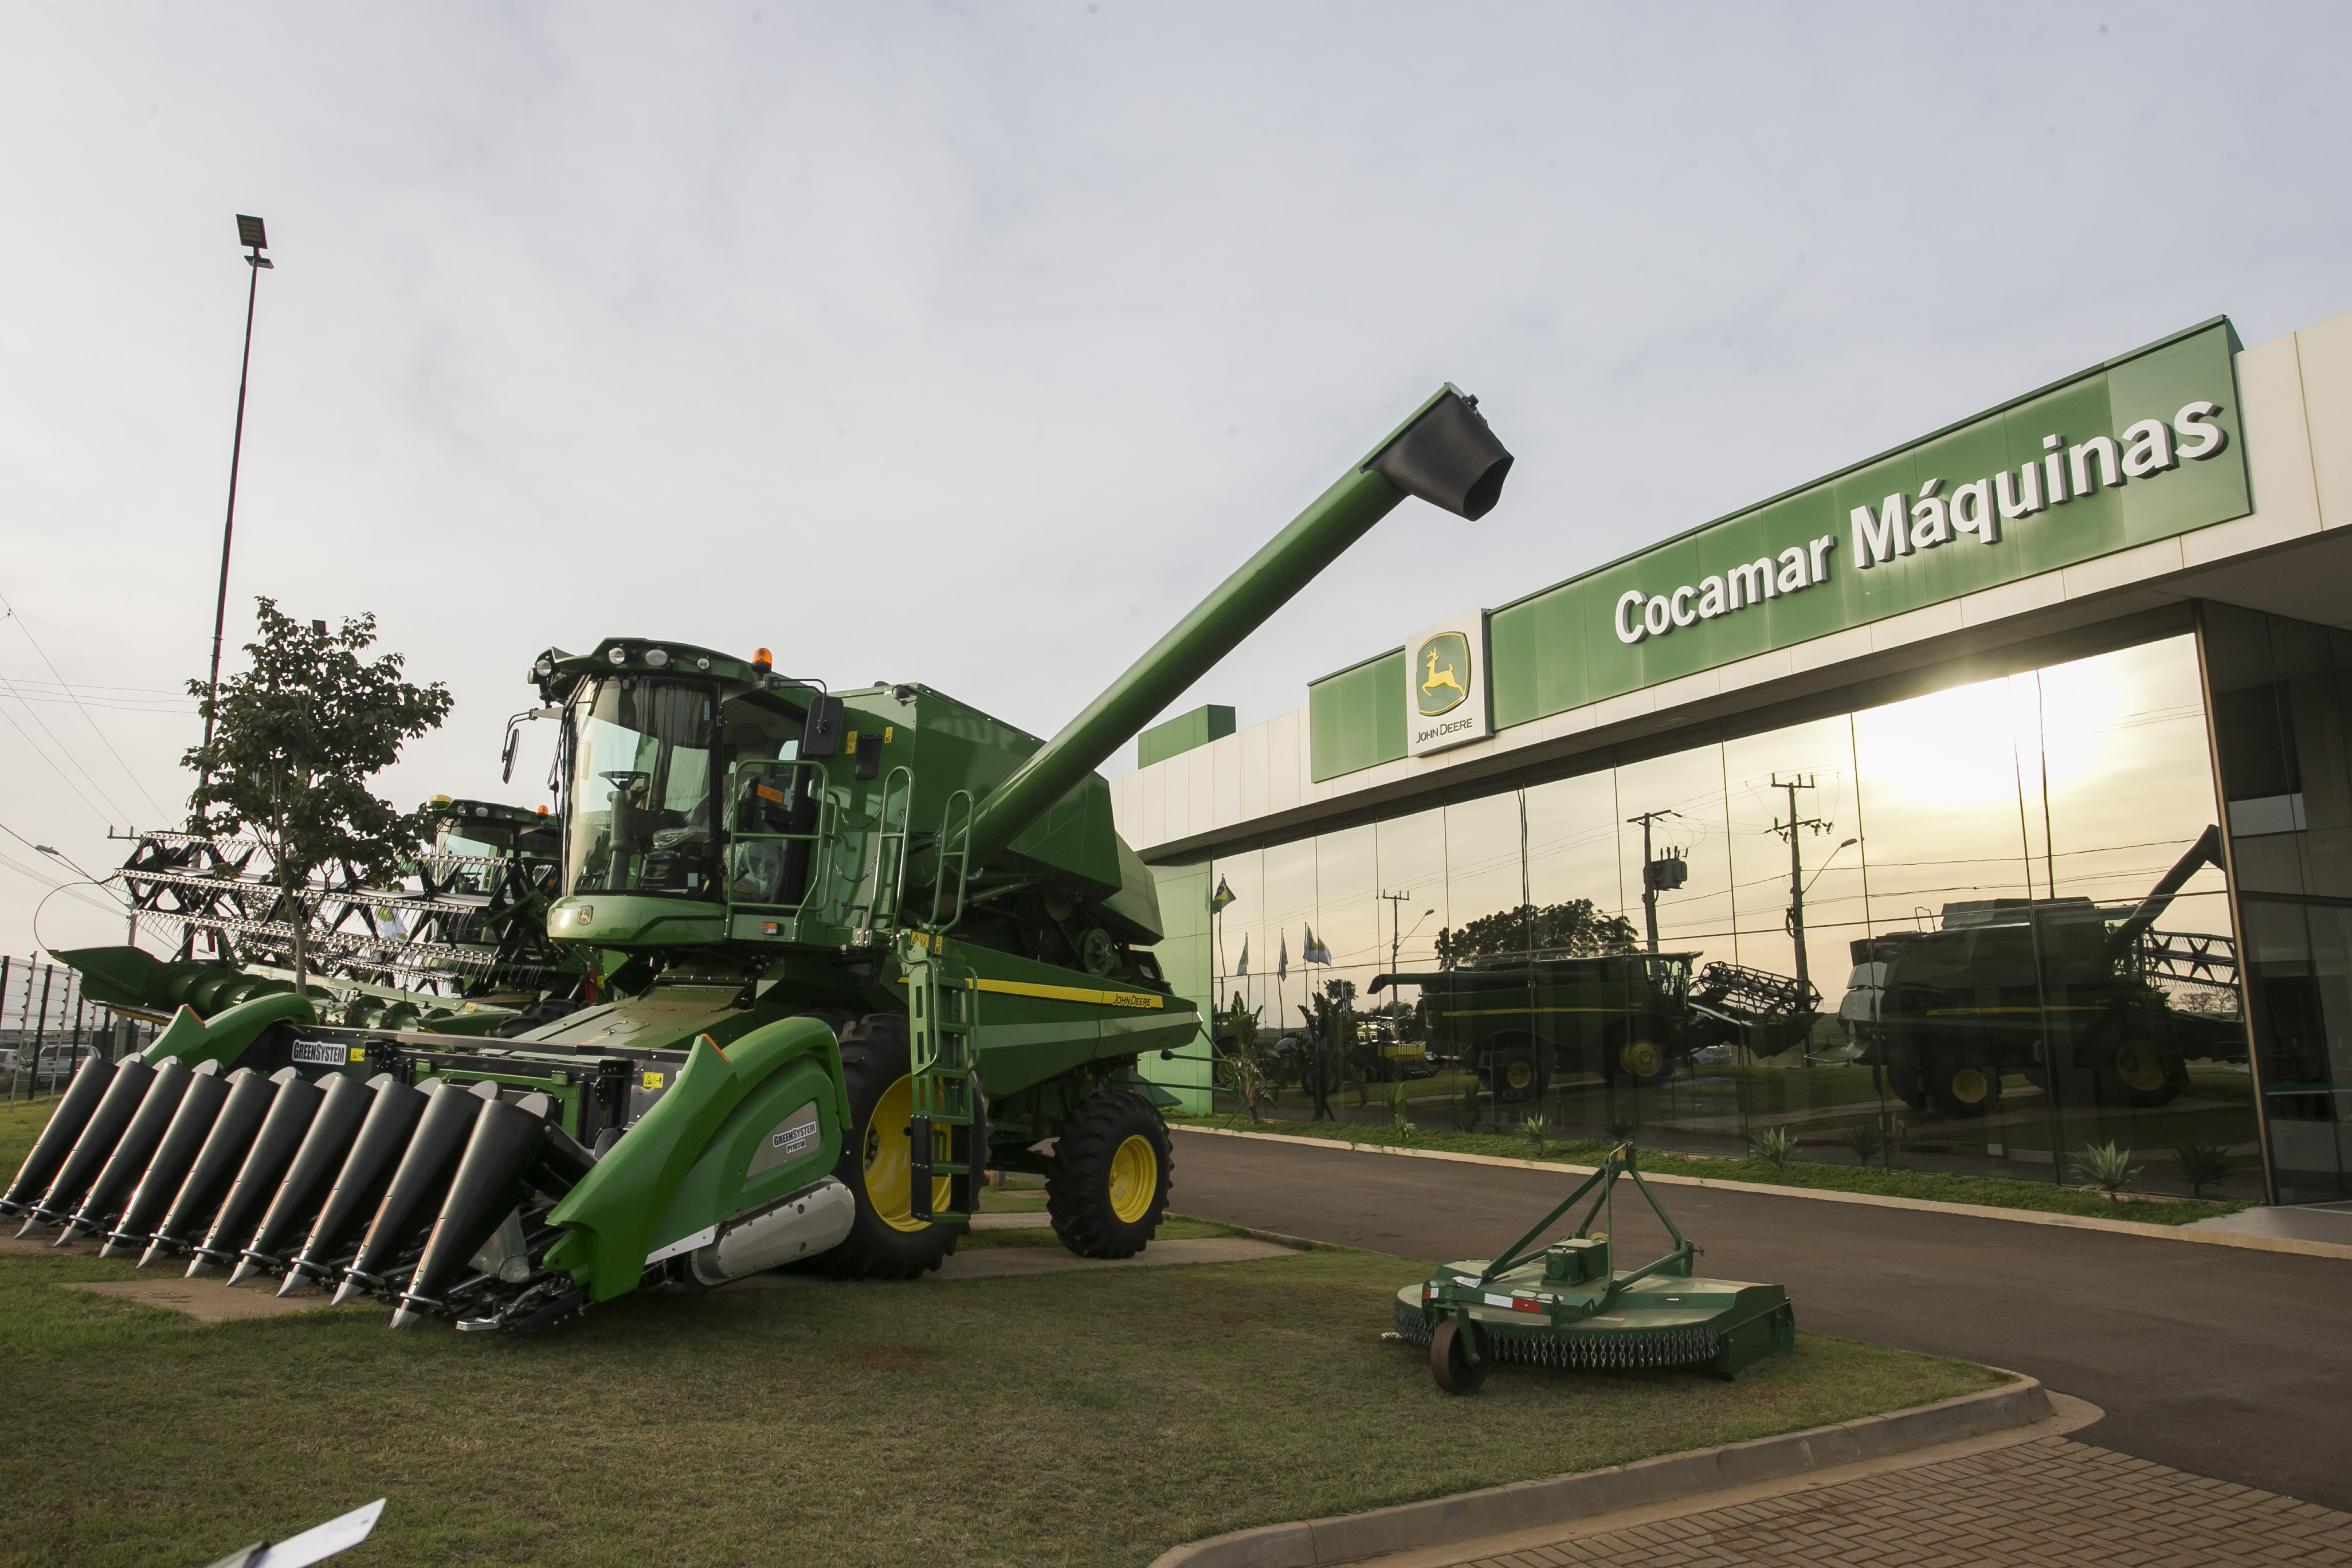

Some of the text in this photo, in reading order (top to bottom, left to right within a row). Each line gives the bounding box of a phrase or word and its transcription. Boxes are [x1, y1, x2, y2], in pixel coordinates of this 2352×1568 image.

[1615, 401, 2224, 643] Cocamar Máquinas
[1416, 718, 1473, 743] JOHN DEERE
[1113, 994, 1151, 1007] JOHN DEERE
